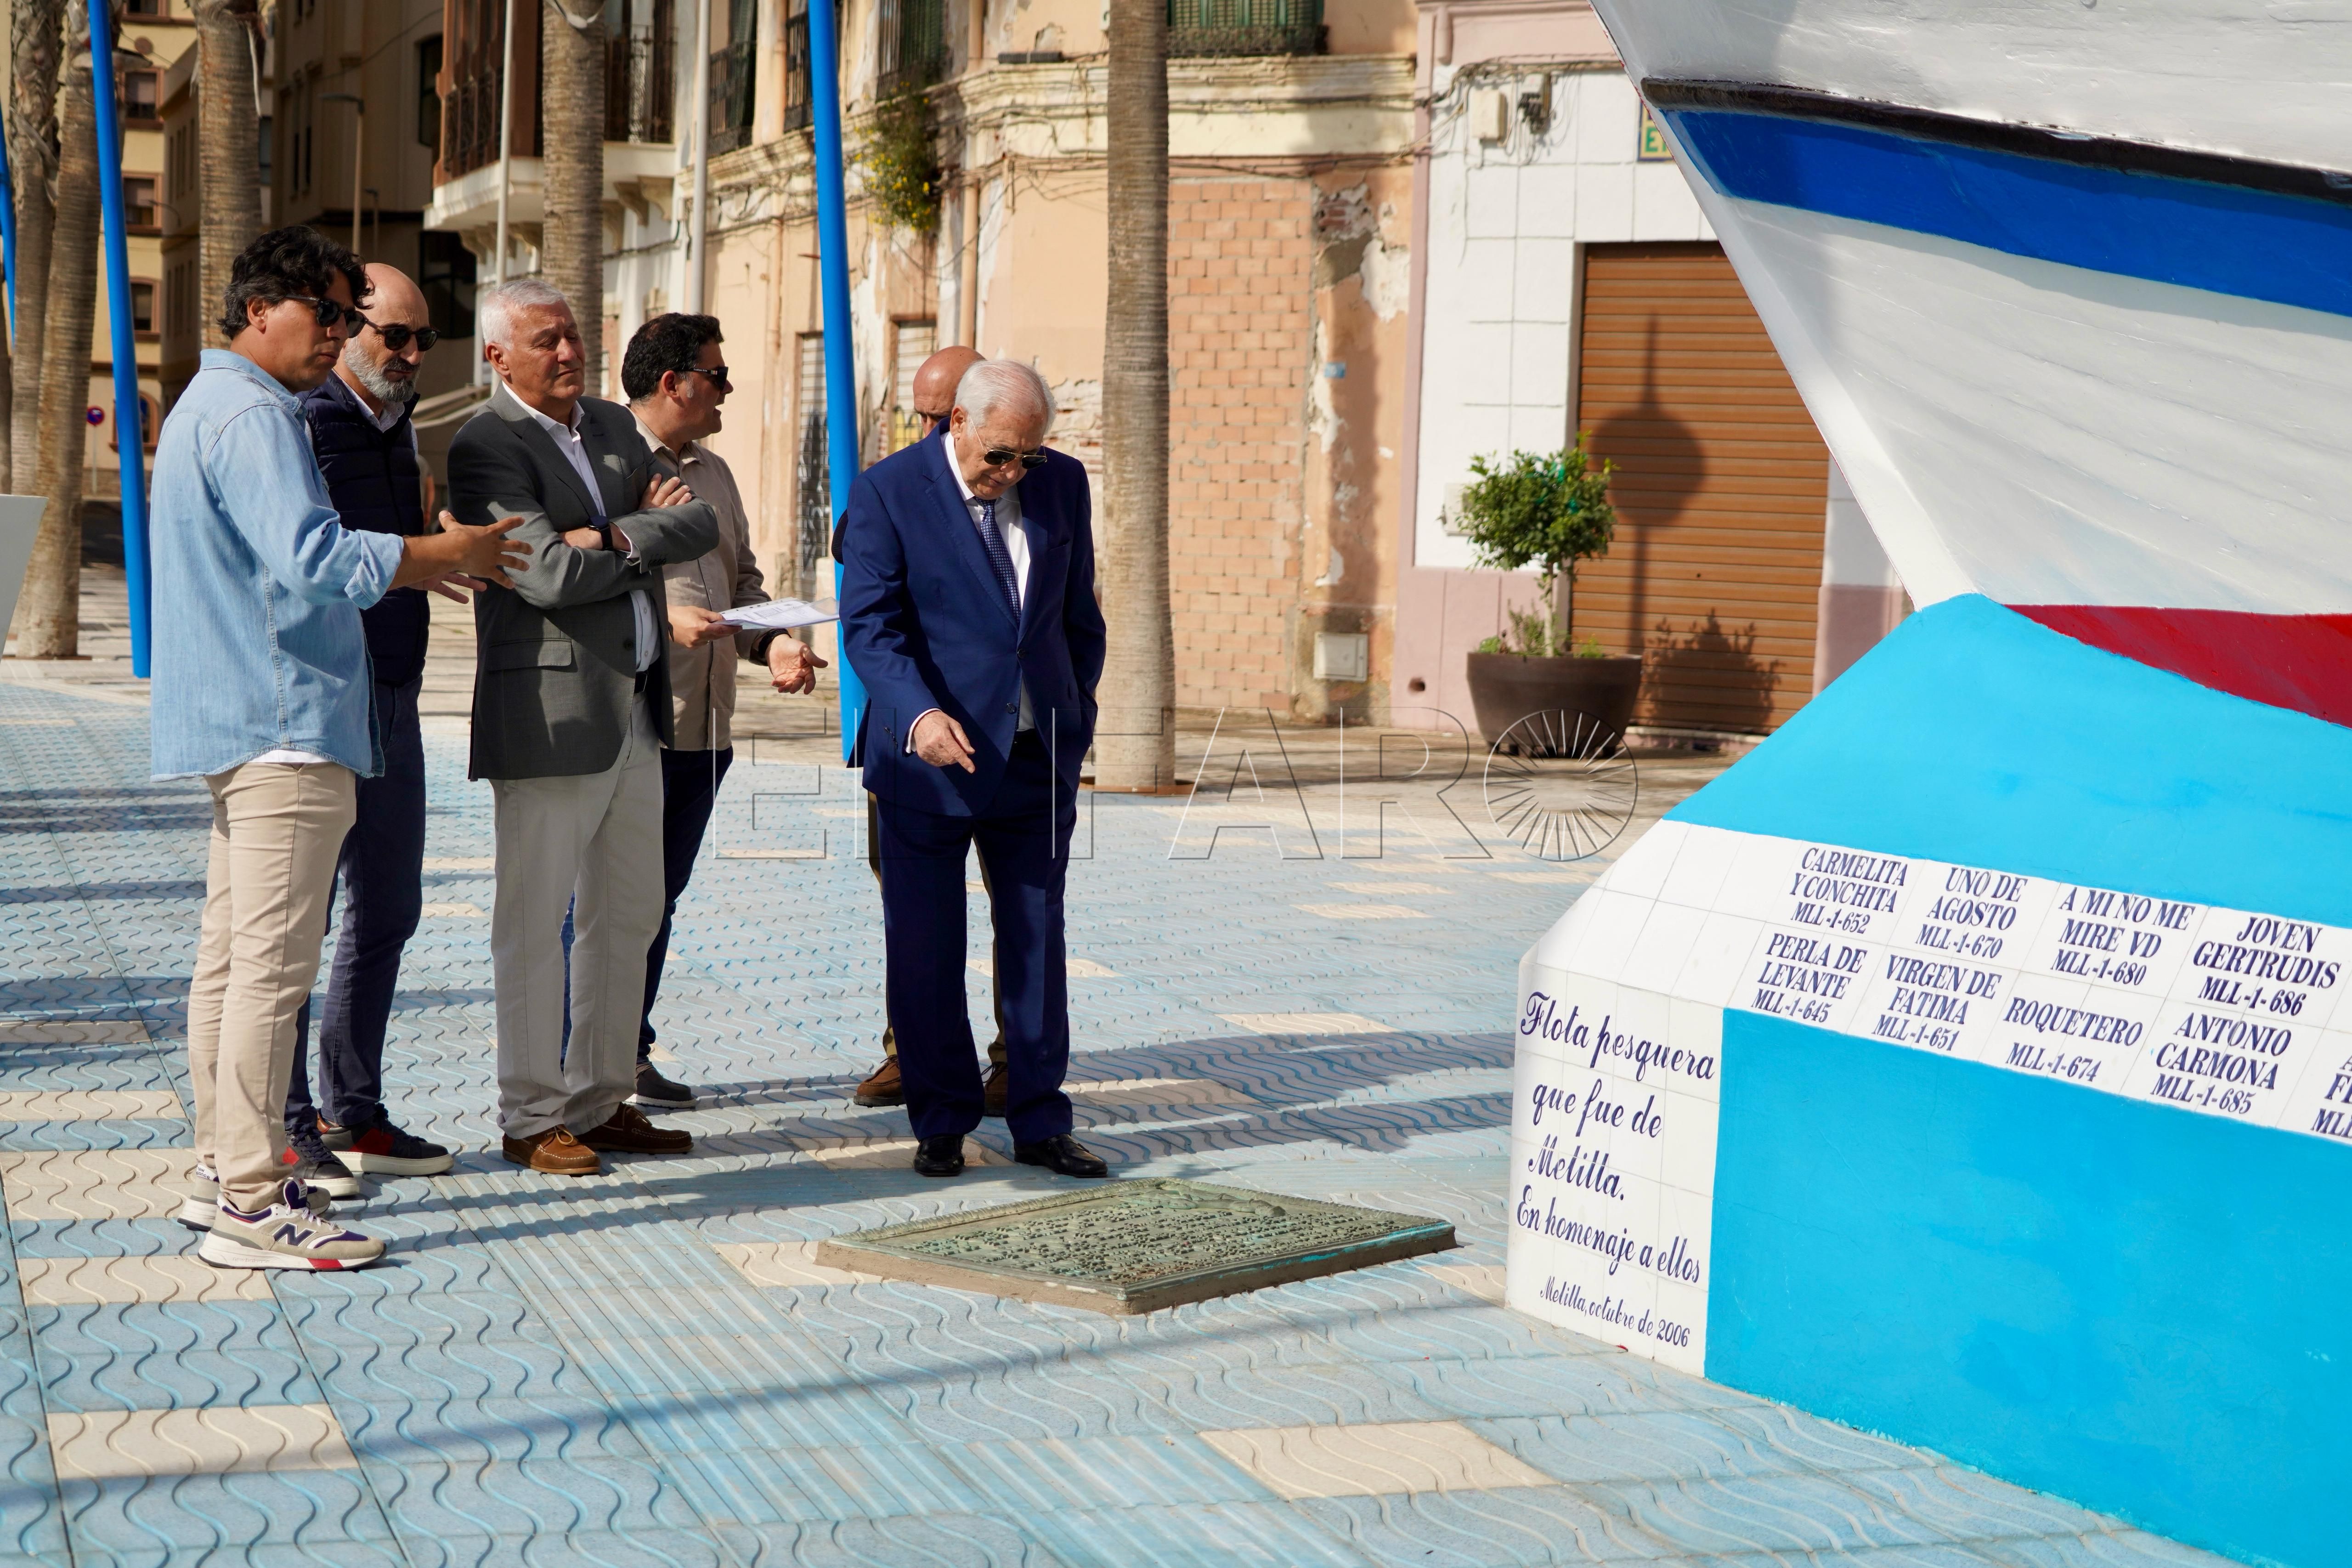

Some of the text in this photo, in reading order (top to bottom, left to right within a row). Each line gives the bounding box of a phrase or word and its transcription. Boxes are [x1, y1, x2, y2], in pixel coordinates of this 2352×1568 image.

[1802, 848, 1908, 886] CARMELITA
[1946, 867, 2027, 901] UNO DE
[1790, 873, 1898, 912] Y CONCHITA
[2058, 887, 2195, 930] A MI NO ME
[1791, 902, 1870, 934] MLL-1-652
[1927, 896, 2016, 930] AGOSTO
[1766, 934, 1867, 973] PERLA DE
[1915, 924, 2002, 958] MLL-1-670
[2058, 918, 2161, 958] MIRE VD
[2237, 917, 2323, 953] JOVEN
[1758, 962, 1851, 999] LEVANTE
[1886, 955, 2001, 999] VIRGEN DE
[2050, 949, 2146, 985] MLL-1-680
[2193, 940, 2341, 989] GERTRUDIS
[1751, 989, 1832, 1023] MLL-1-645
[1888, 987, 1969, 1025] FATIMA
[2003, 997, 2143, 1046] ROQUETERO
[1521, 991, 1714, 1082] Flota pesquera
[1871, 1014, 1960, 1051] MLL-1-651
[2173, 1012, 2291, 1056] ANTONIO
[2005, 1042, 2101, 1081] MLL-1-674
[2156, 1042, 2278, 1090] CARMONA
[1533, 1079, 1661, 1138] que fue de
[2150, 1073, 2256, 1114] MLL-1-685
[1529, 1134, 1624, 1200] Melilla.
[1517, 1184, 1699, 1283] En homenaje a ellos
[1540, 1276, 1690, 1347] Melilla, octubre de 2006
